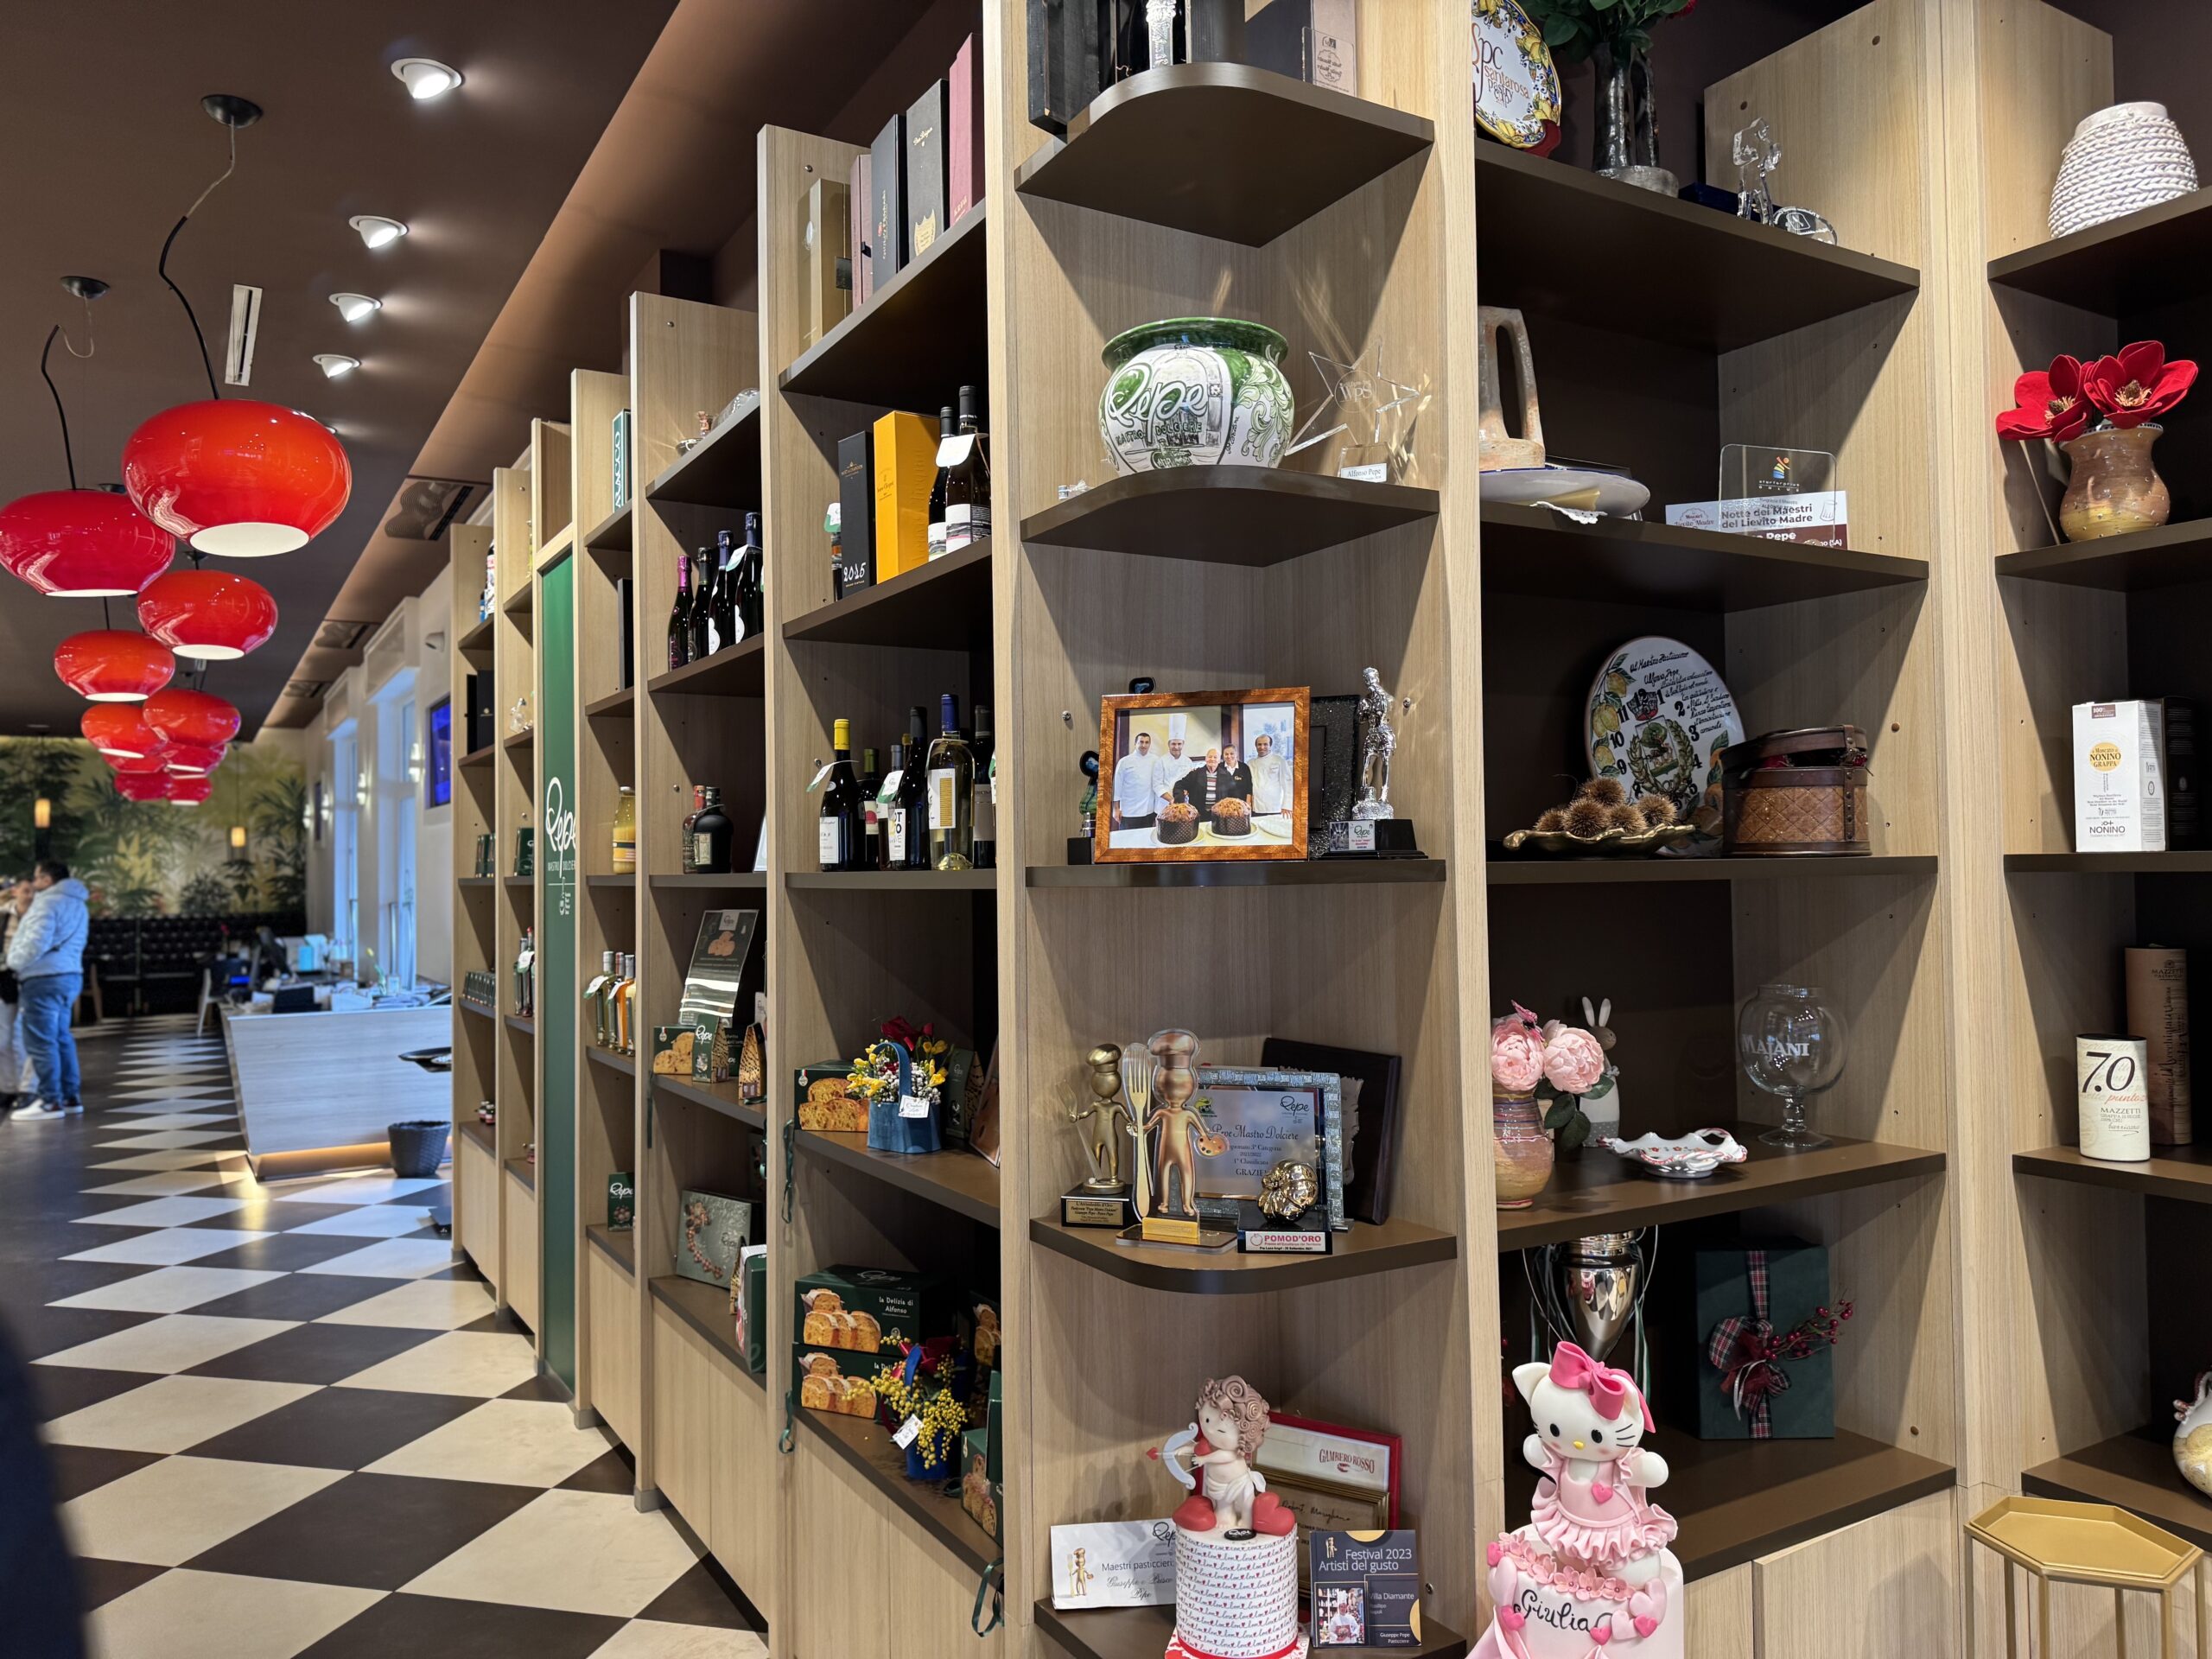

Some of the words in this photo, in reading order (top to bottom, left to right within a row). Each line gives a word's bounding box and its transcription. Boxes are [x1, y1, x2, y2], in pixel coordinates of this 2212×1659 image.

[1105, 363, 1208, 444] Pepe
[1721, 511, 1751, 519] Notte
[1753, 508, 1770, 518] dei
[1773, 504, 1813, 516] Maestri
[1722, 519, 1738, 529] del
[1741, 517, 1777, 527] Lievito
[1779, 514, 1813, 524] Madre
[1766, 531, 1797, 542] Pepe
[843, 563, 866, 582] 2015
[1618, 704, 1630, 724] 11
[1675, 701, 1685, 717] 2
[1610, 731, 1624, 748] 10
[1688, 725, 1700, 741] 3
[1617, 759, 1627, 775] 9
[1694, 753, 1702, 769] 4
[2089, 825, 2126, 834] NONINO
[696, 1025, 712, 1045] Pepe
[1742, 1033, 1810, 1062] MAJANI
[2082, 1051, 2135, 1094] 7.0
[1280, 1095, 1309, 1116] Pepe
[1233, 1124, 1264, 1138] Mastro
[1265, 1125, 1299, 1140] Dolciere
[887, 1297, 906, 1306] Delizia
[1319, 1449, 1352, 1463] GAMBERO
[1353, 1455, 1376, 1473] ROSSO
[1153, 1522, 1175, 1547] Pep
[1345, 1548, 1383, 1560] Festival
[1385, 1548, 1412, 1560] 2023
[1102, 1561, 1131, 1572] Maestri
[1134, 1560, 1174, 1571] pasticcieri:
[1319, 1560, 1349, 1571] Artisti
[1351, 1560, 1367, 1571] del
[1370, 1560, 1399, 1573] gusto
[1514, 1589, 1592, 1633] Giulia
